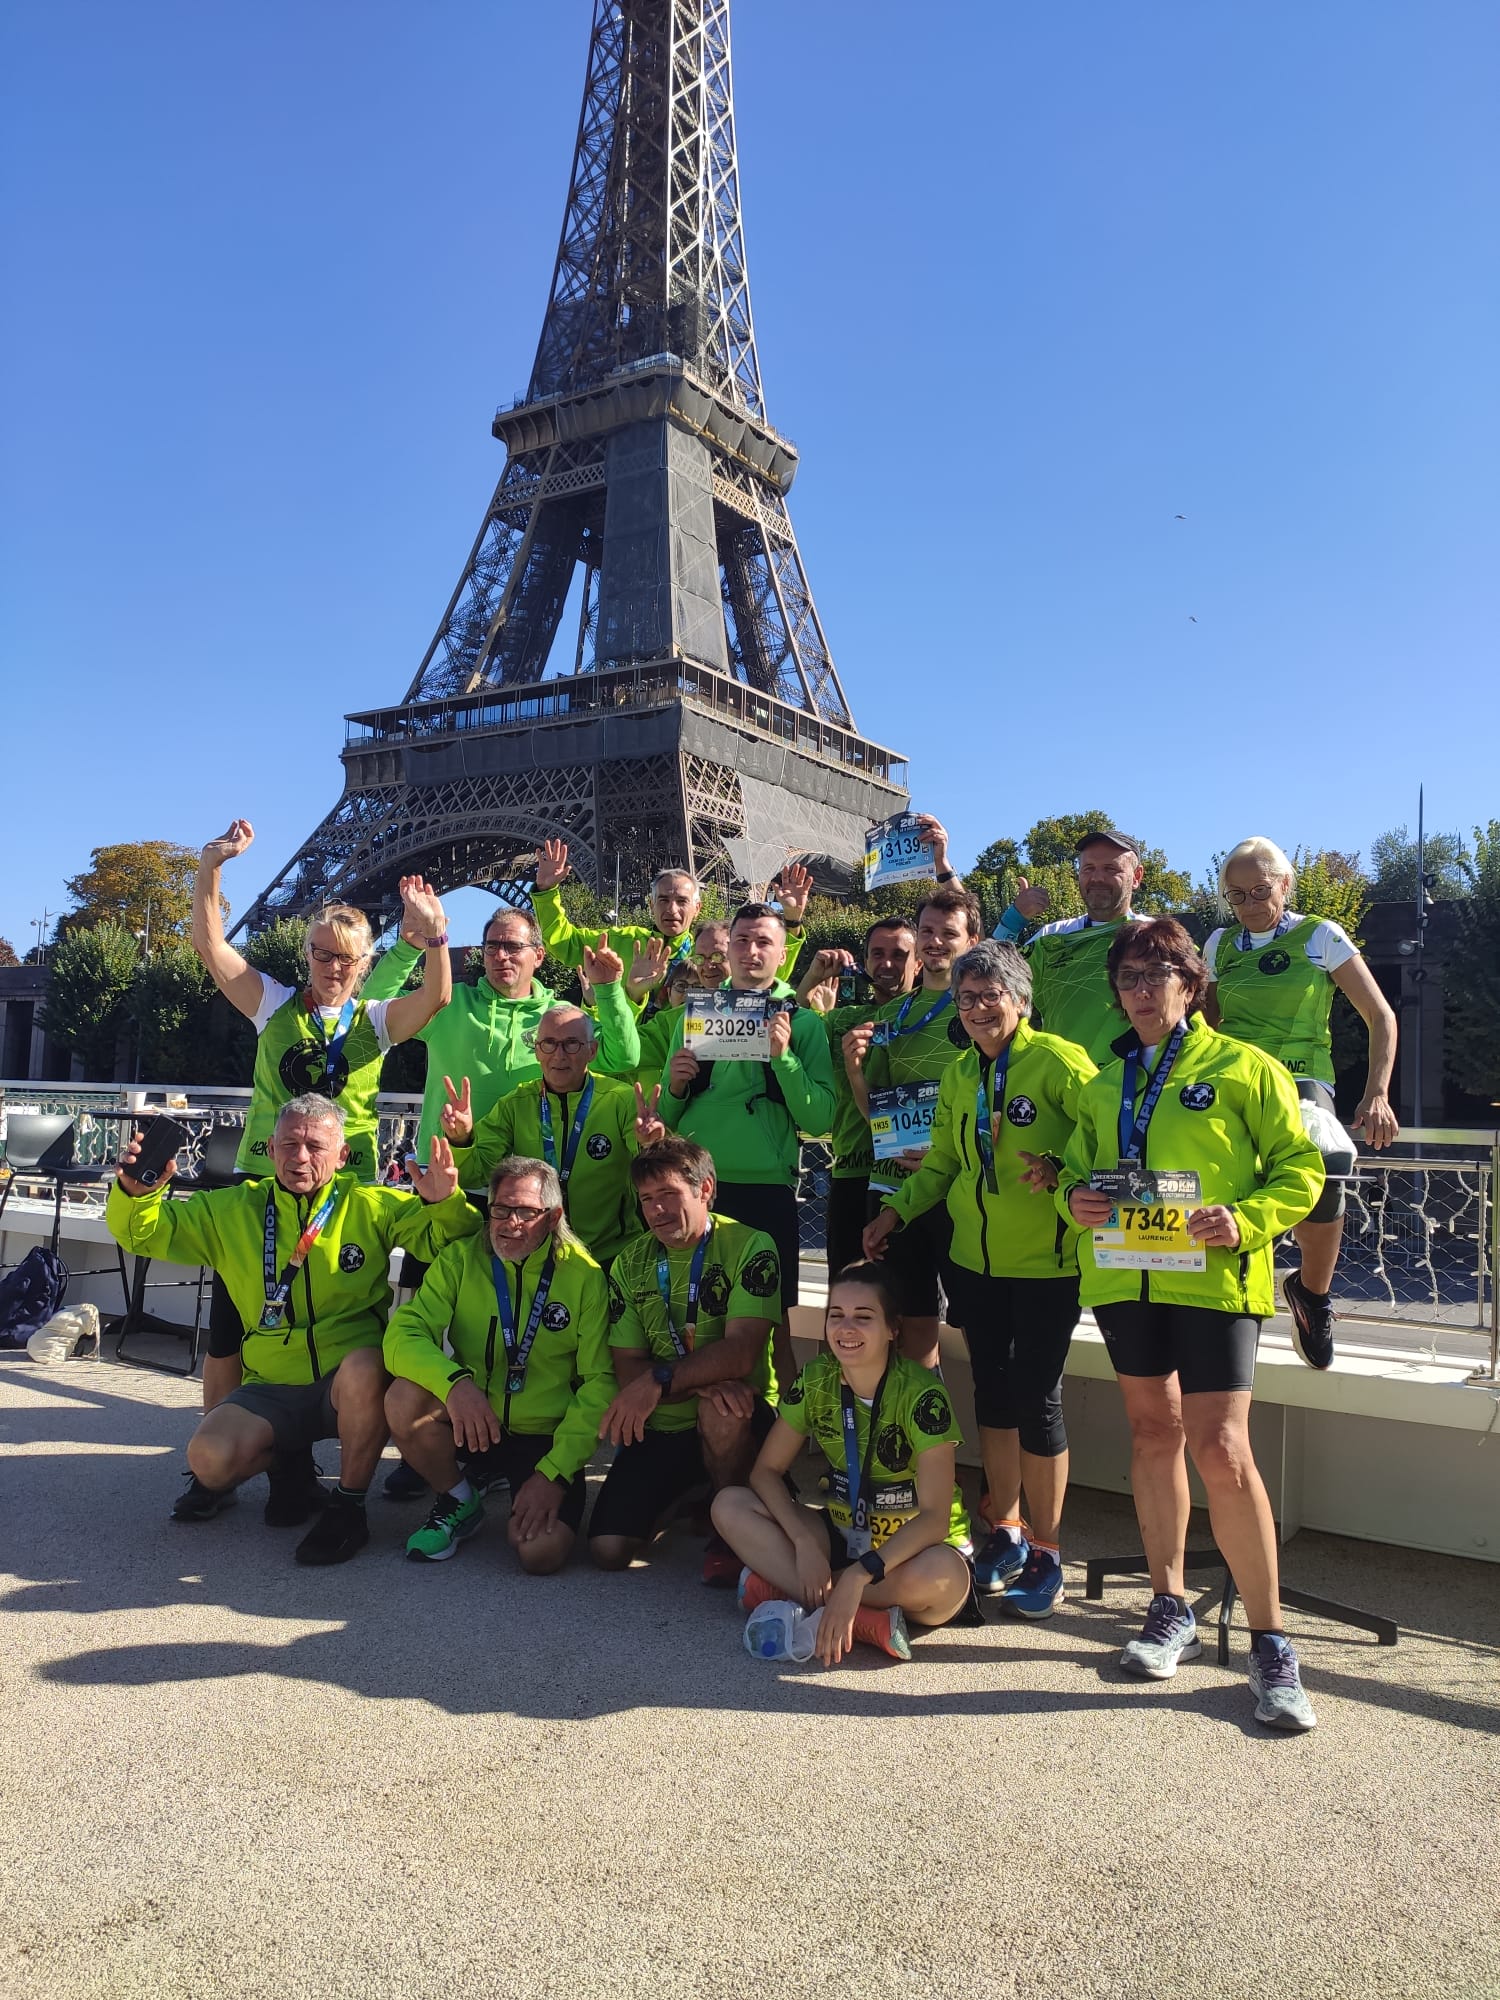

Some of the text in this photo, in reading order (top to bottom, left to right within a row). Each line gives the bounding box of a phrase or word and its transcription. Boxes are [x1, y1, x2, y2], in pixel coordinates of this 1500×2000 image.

[879, 837, 920, 861] 13139
[687, 1021, 702, 1031] 1H35
[704, 1019, 756, 1036] 23029
[1135, 1026, 1187, 1134] APESANTEU
[874, 1121, 889, 1130] 1H35
[1123, 1207, 1180, 1232] 7342
[264, 1204, 275, 1276] COUREZ
[1138, 1234, 1174, 1242] LAURENCE
[517, 1291, 547, 1366] ANTEUR
[832, 1509, 846, 1521] 1H35
